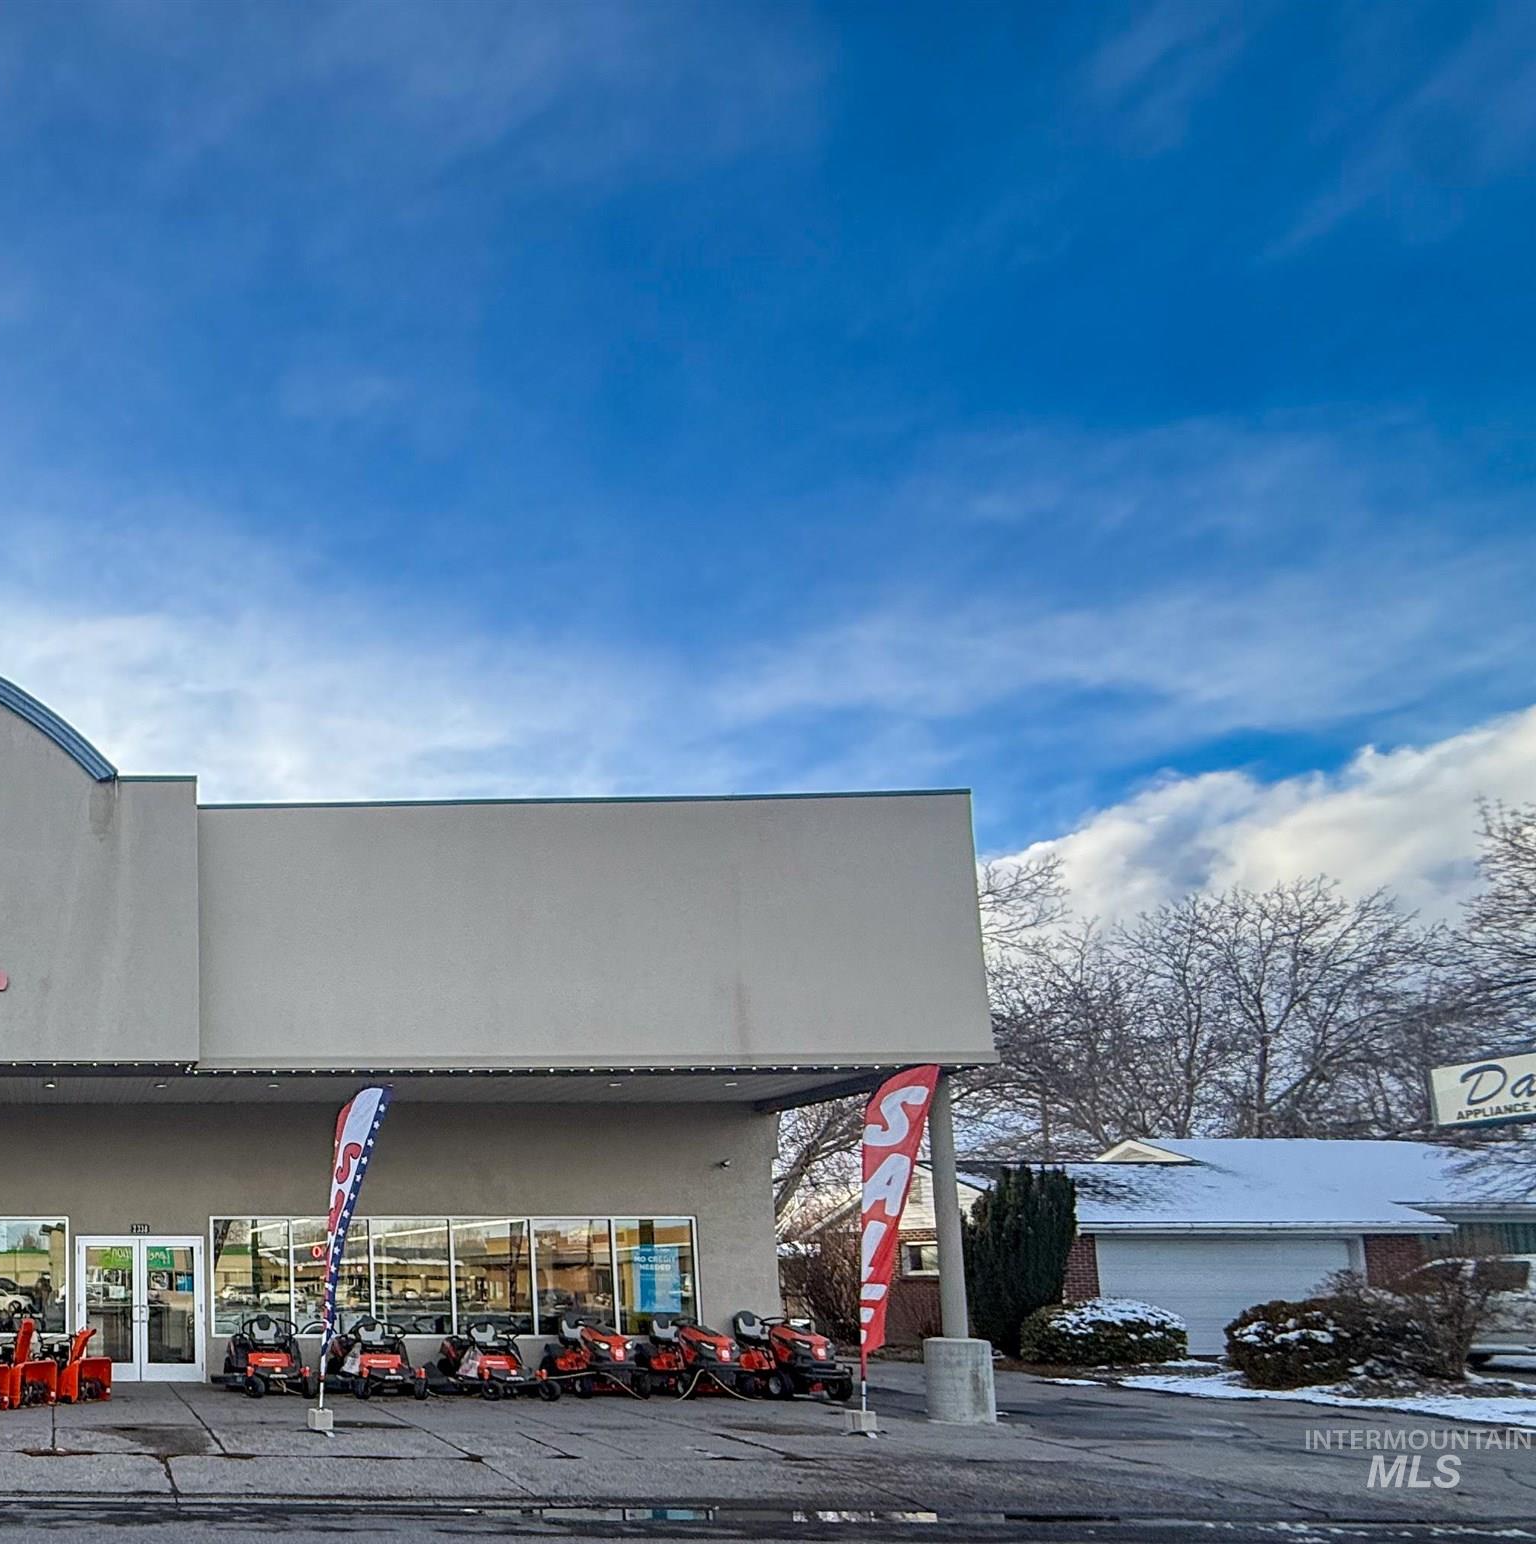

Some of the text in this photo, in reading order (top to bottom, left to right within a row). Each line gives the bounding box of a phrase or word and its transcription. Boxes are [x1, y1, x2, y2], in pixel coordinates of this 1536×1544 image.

[1456, 1102, 1532, 1121] APPLIANCE
[647, 1255, 676, 1263] CREDIT
[639, 1263, 672, 1271] NEEDED
